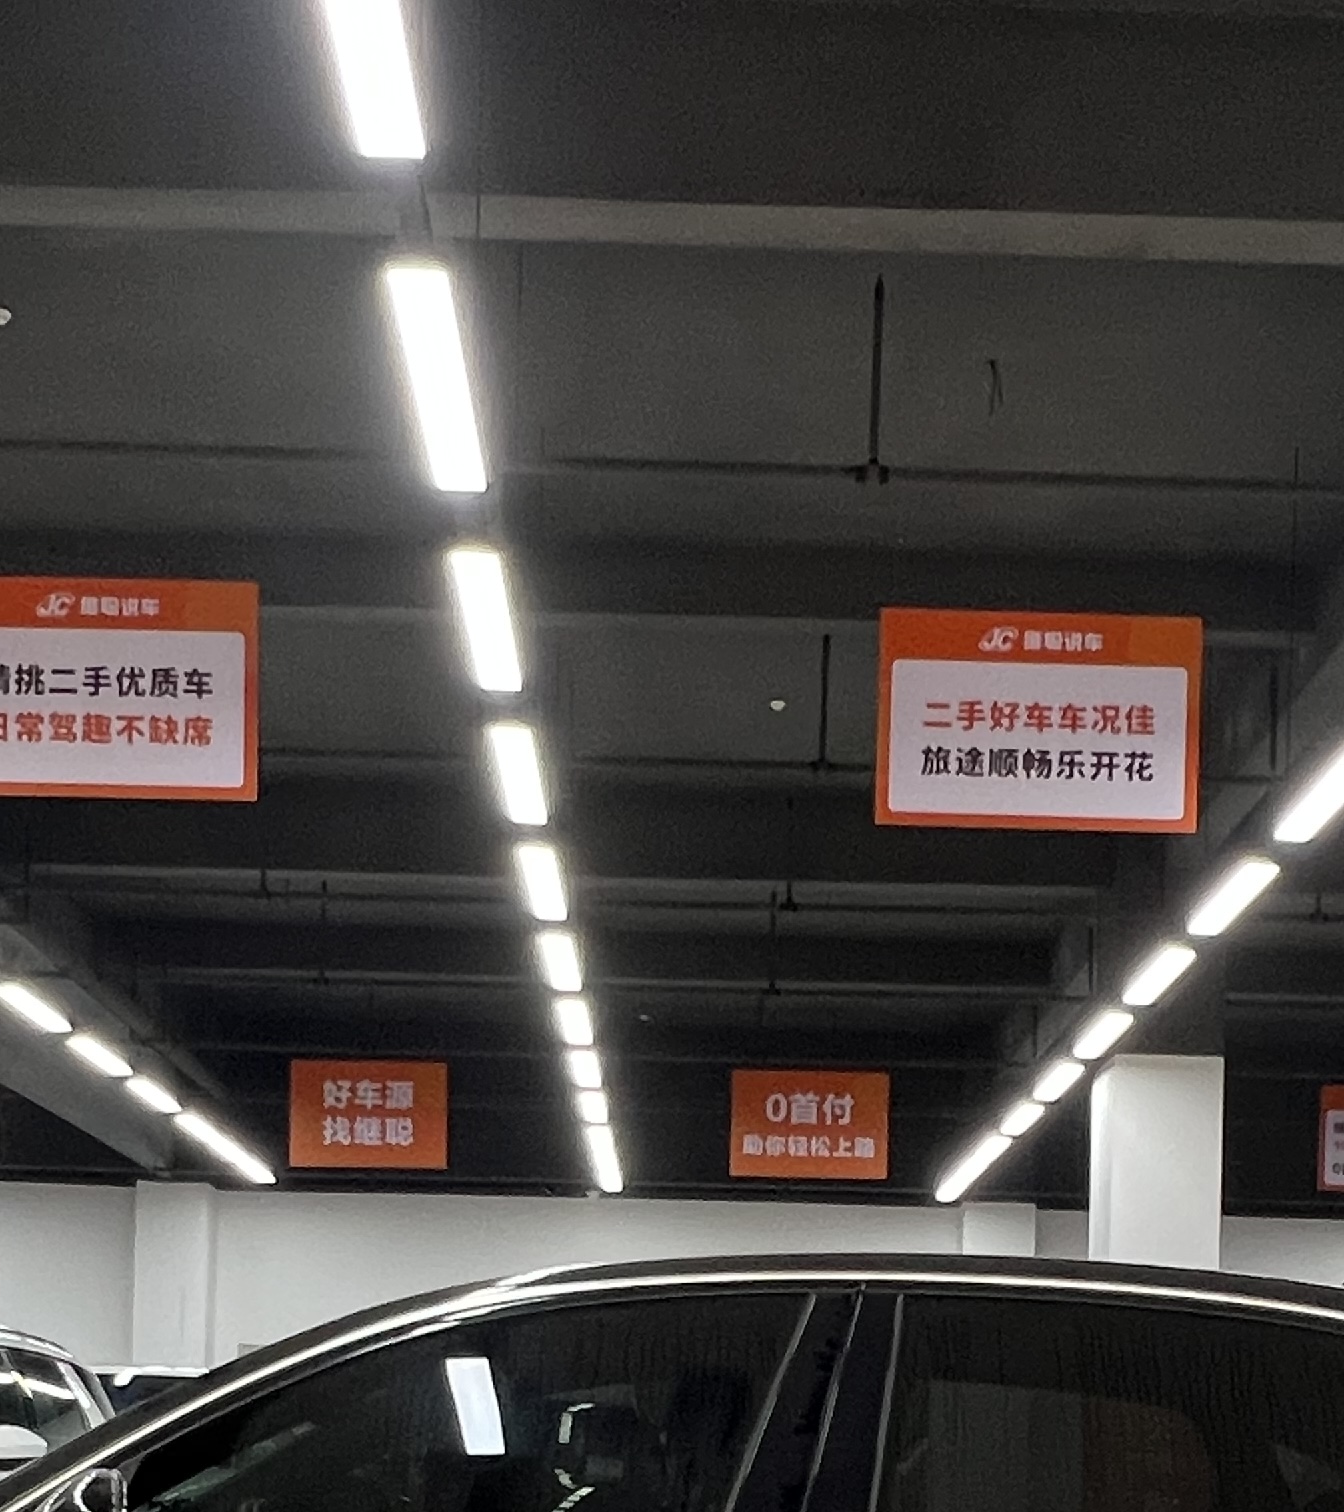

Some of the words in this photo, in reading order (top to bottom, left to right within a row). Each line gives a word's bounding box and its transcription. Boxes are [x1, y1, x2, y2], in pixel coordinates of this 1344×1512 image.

[923, 700, 1155, 736] 二手好车车况佳
[921, 745, 1154, 781] 旅途顺畅乐开花
[765, 1091, 854, 1126] 0首付
